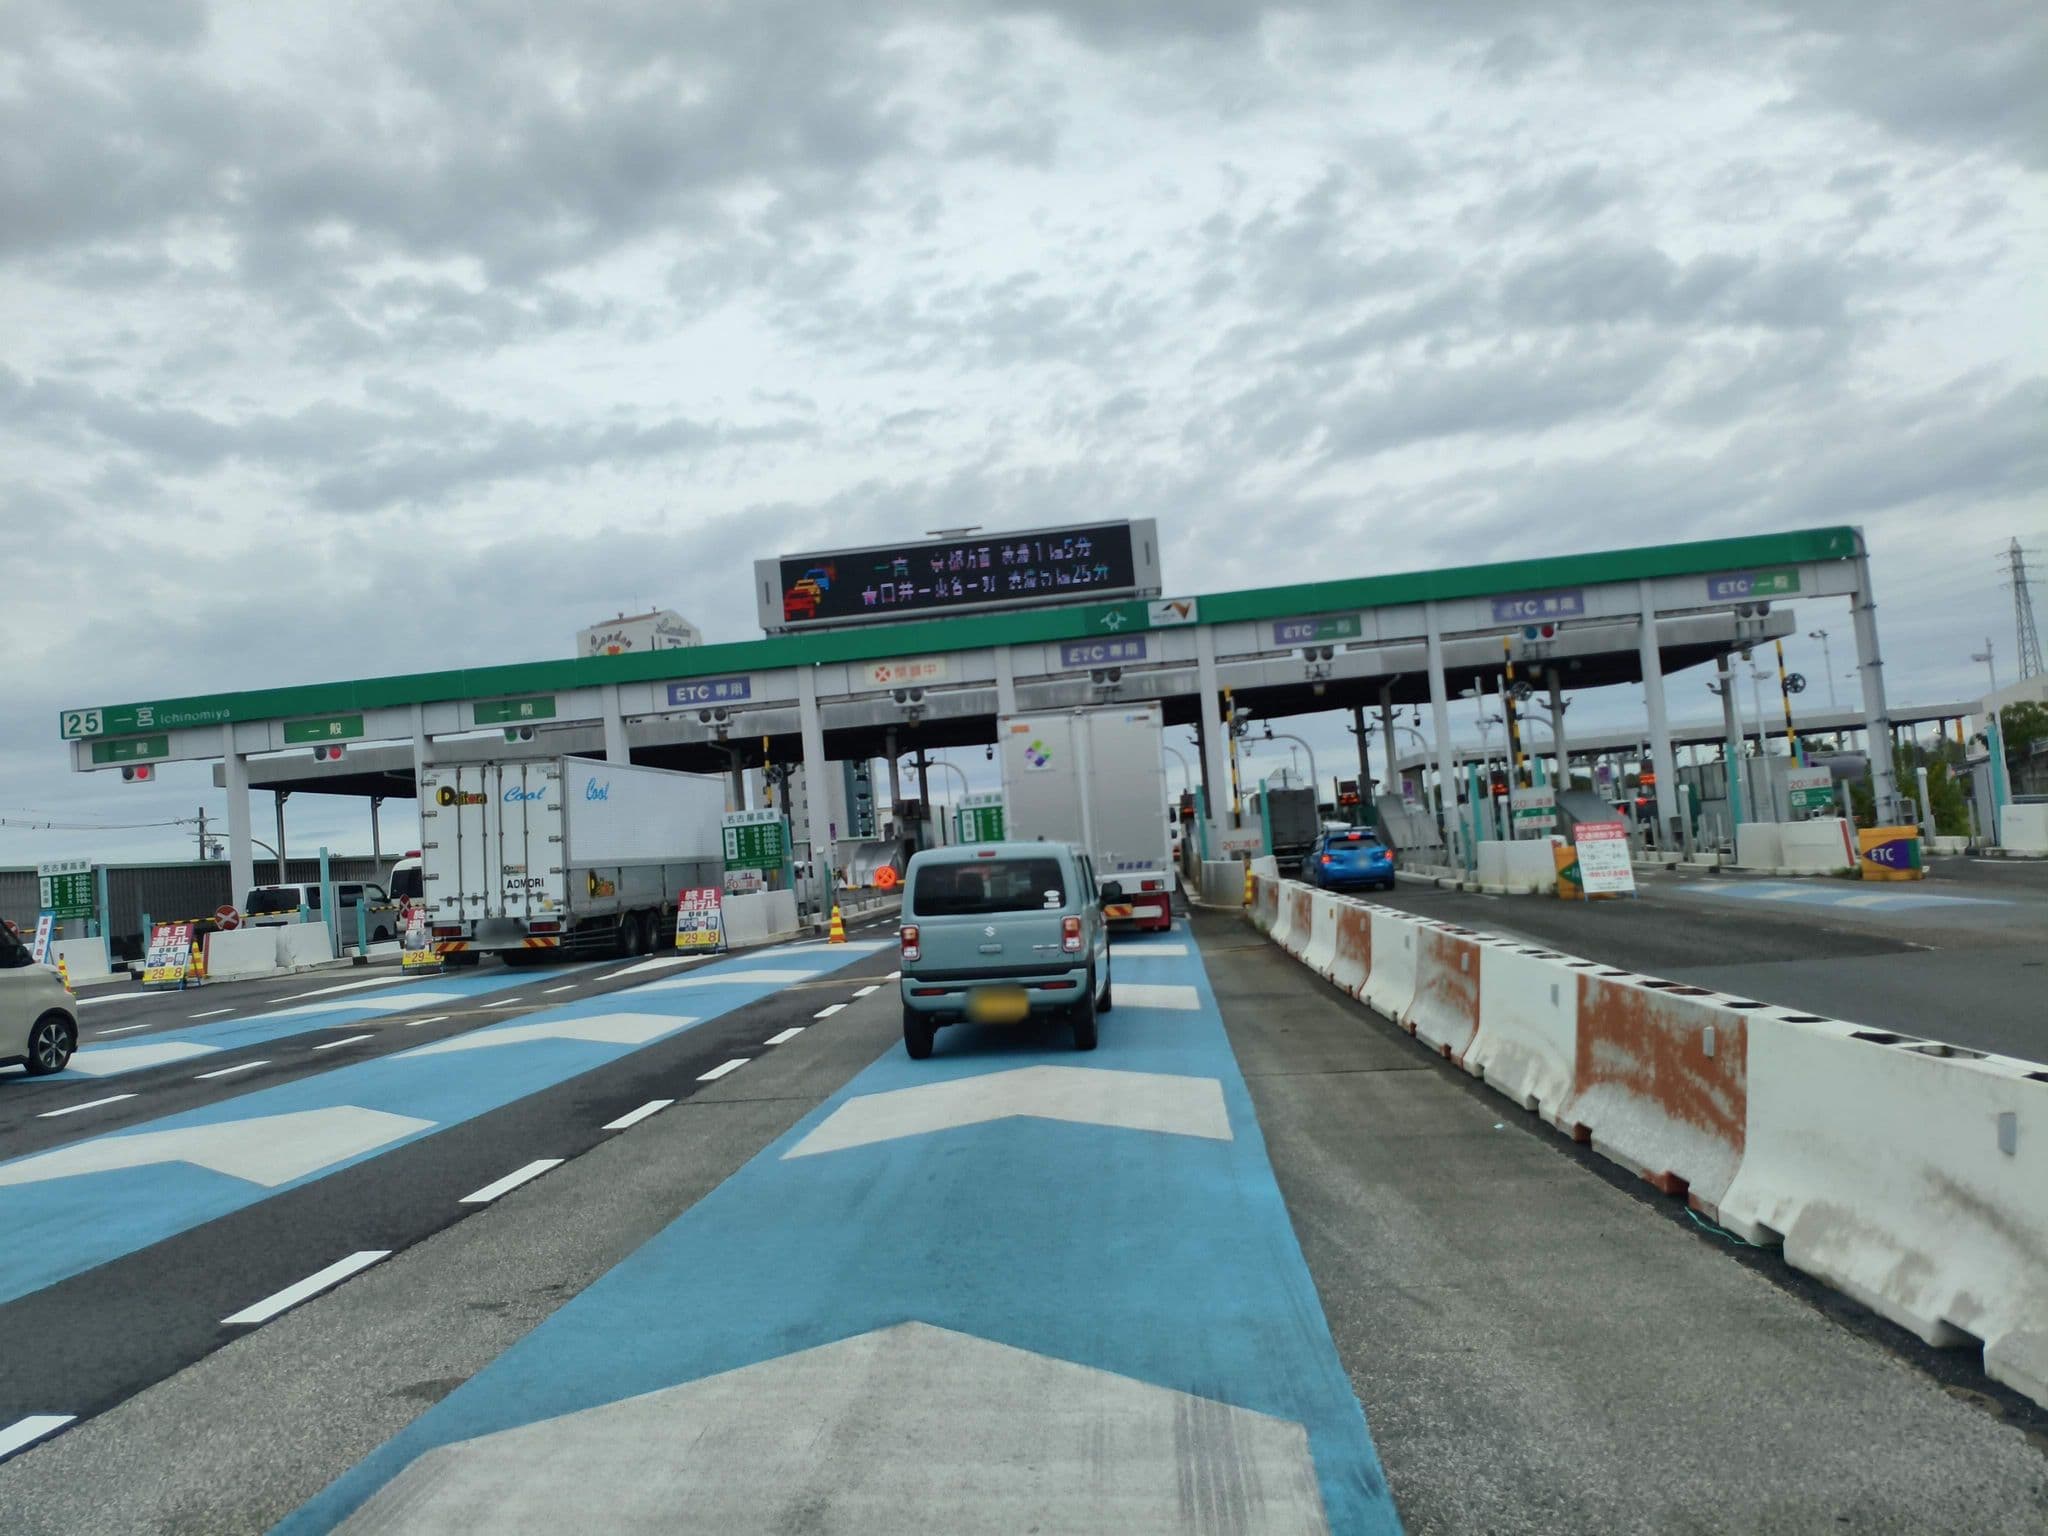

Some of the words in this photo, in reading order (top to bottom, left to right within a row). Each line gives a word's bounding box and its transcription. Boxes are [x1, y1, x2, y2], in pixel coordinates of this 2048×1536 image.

[676, 685, 710, 701] ETC
[68, 713, 99, 734] 25
[114, 707, 154, 727] 一宮
[160, 709, 230, 724] Ichinomiya
[503, 786, 547, 802] Cool
[1871, 848, 1895, 861] ETC
[507, 878, 545, 889] AOMORI
